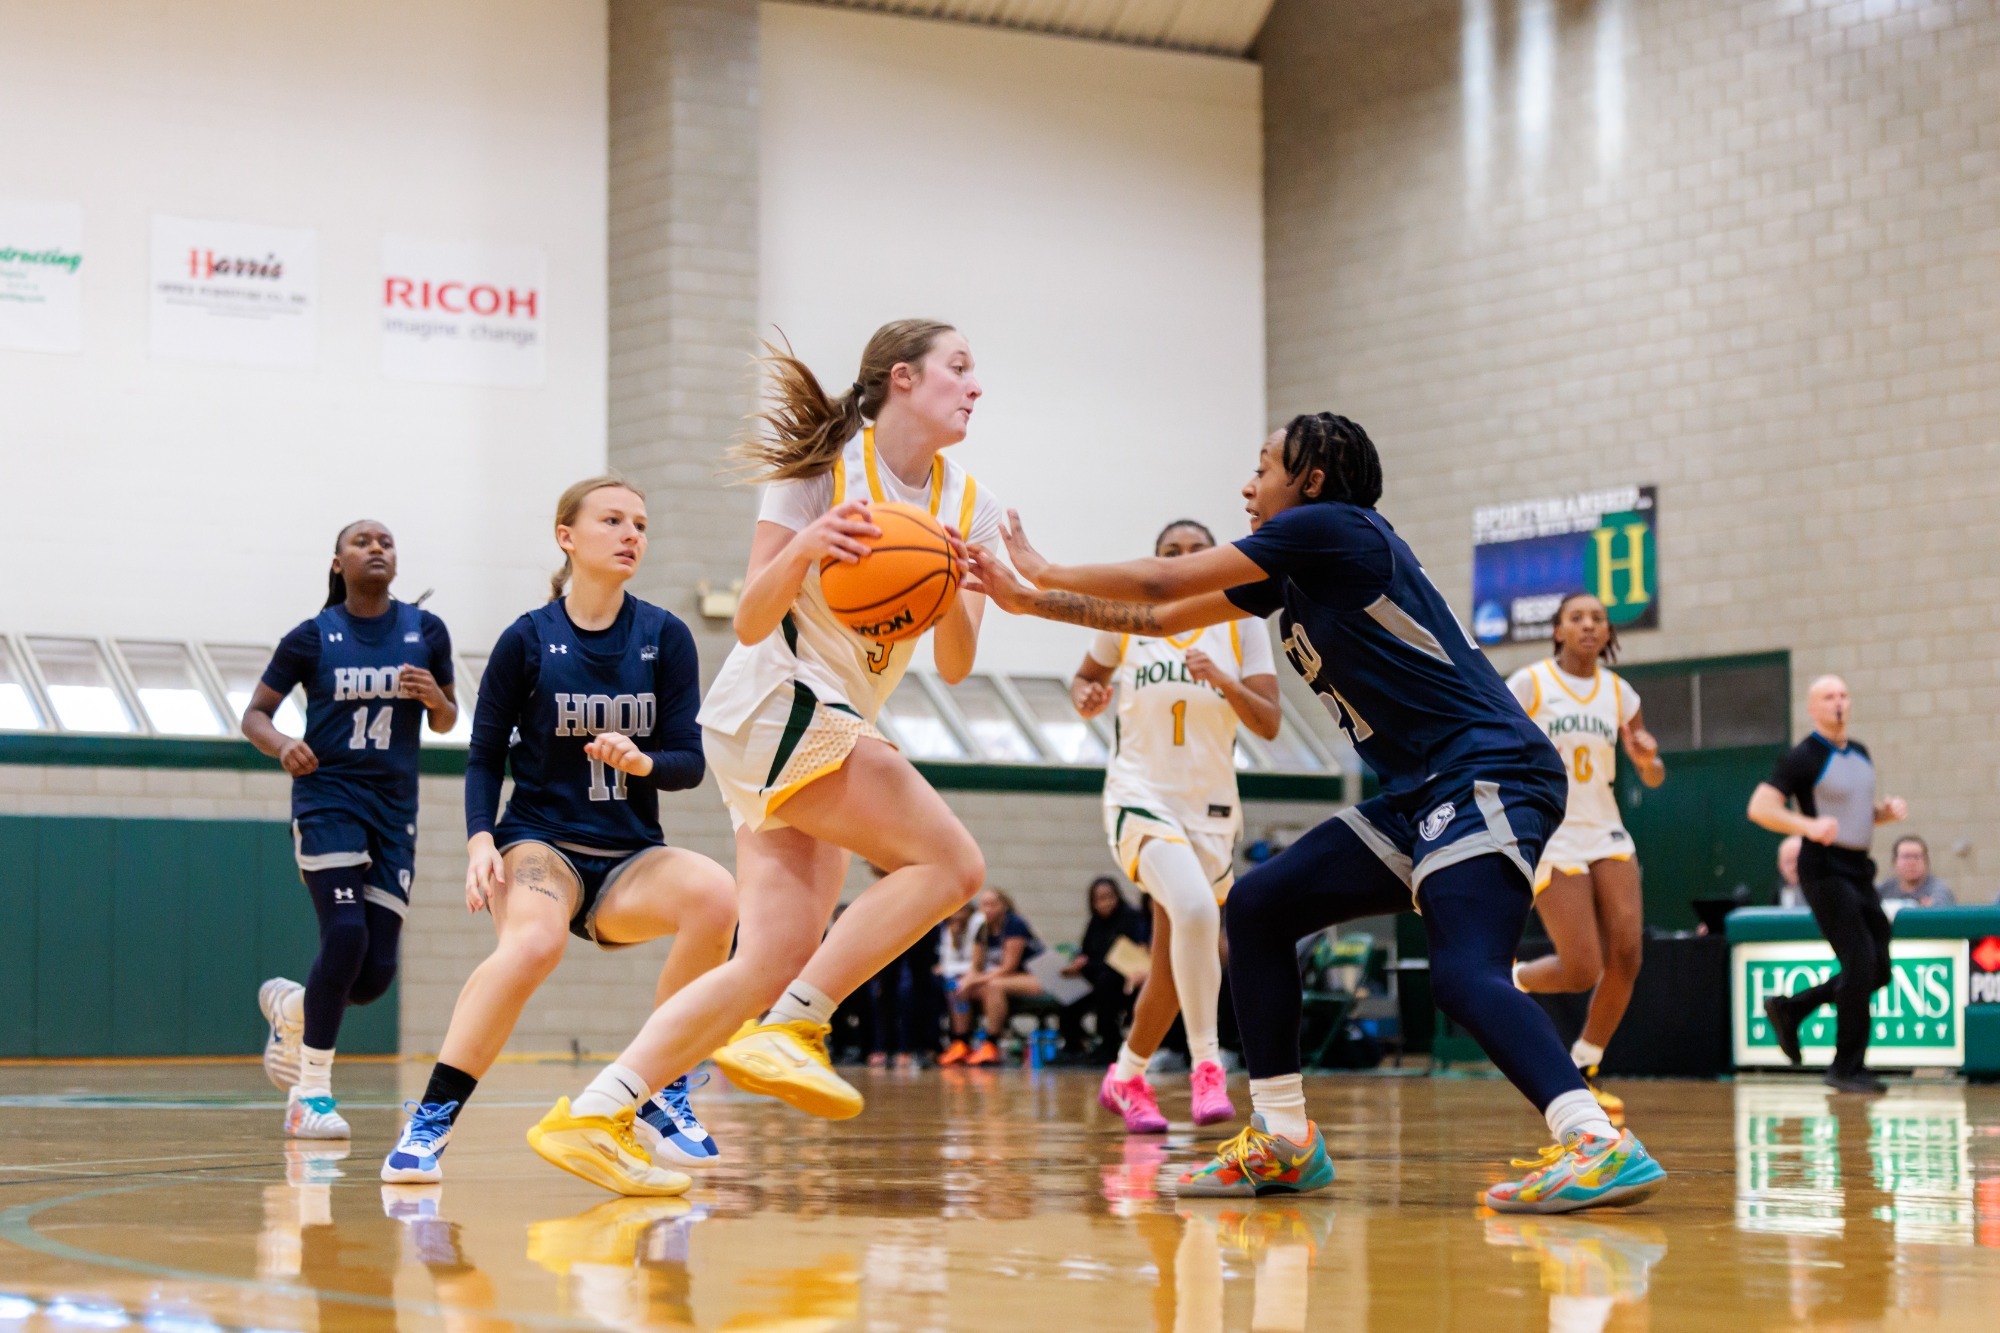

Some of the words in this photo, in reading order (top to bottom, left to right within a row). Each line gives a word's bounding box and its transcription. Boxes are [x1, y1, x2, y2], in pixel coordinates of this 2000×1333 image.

[189, 248, 283, 280] Harris
[384, 276, 538, 320] RICOH
[1593, 521, 1649, 607] H
[334, 665, 413, 701] HOO
[1135, 660, 1226, 699] HOLL
[349, 706, 394, 750] 14
[555, 693, 657, 737] HOOD
[1171, 700, 1187, 746] 1
